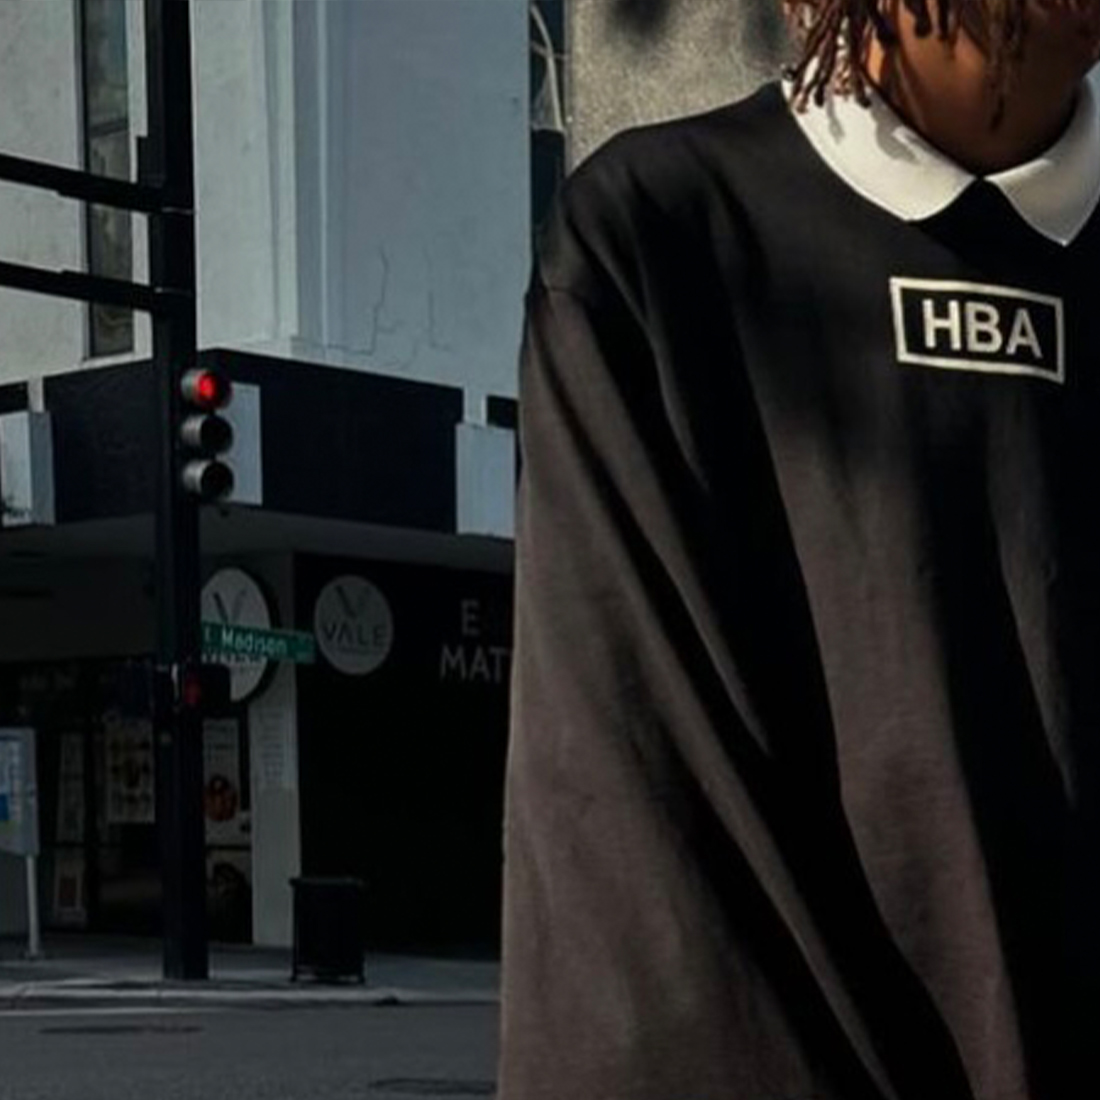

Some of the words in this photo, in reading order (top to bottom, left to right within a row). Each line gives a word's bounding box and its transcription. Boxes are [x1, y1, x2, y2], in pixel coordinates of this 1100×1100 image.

[922, 299, 1043, 358] HBA
[323, 623, 386, 647] VALE
[439, 643, 510, 684] MAT
